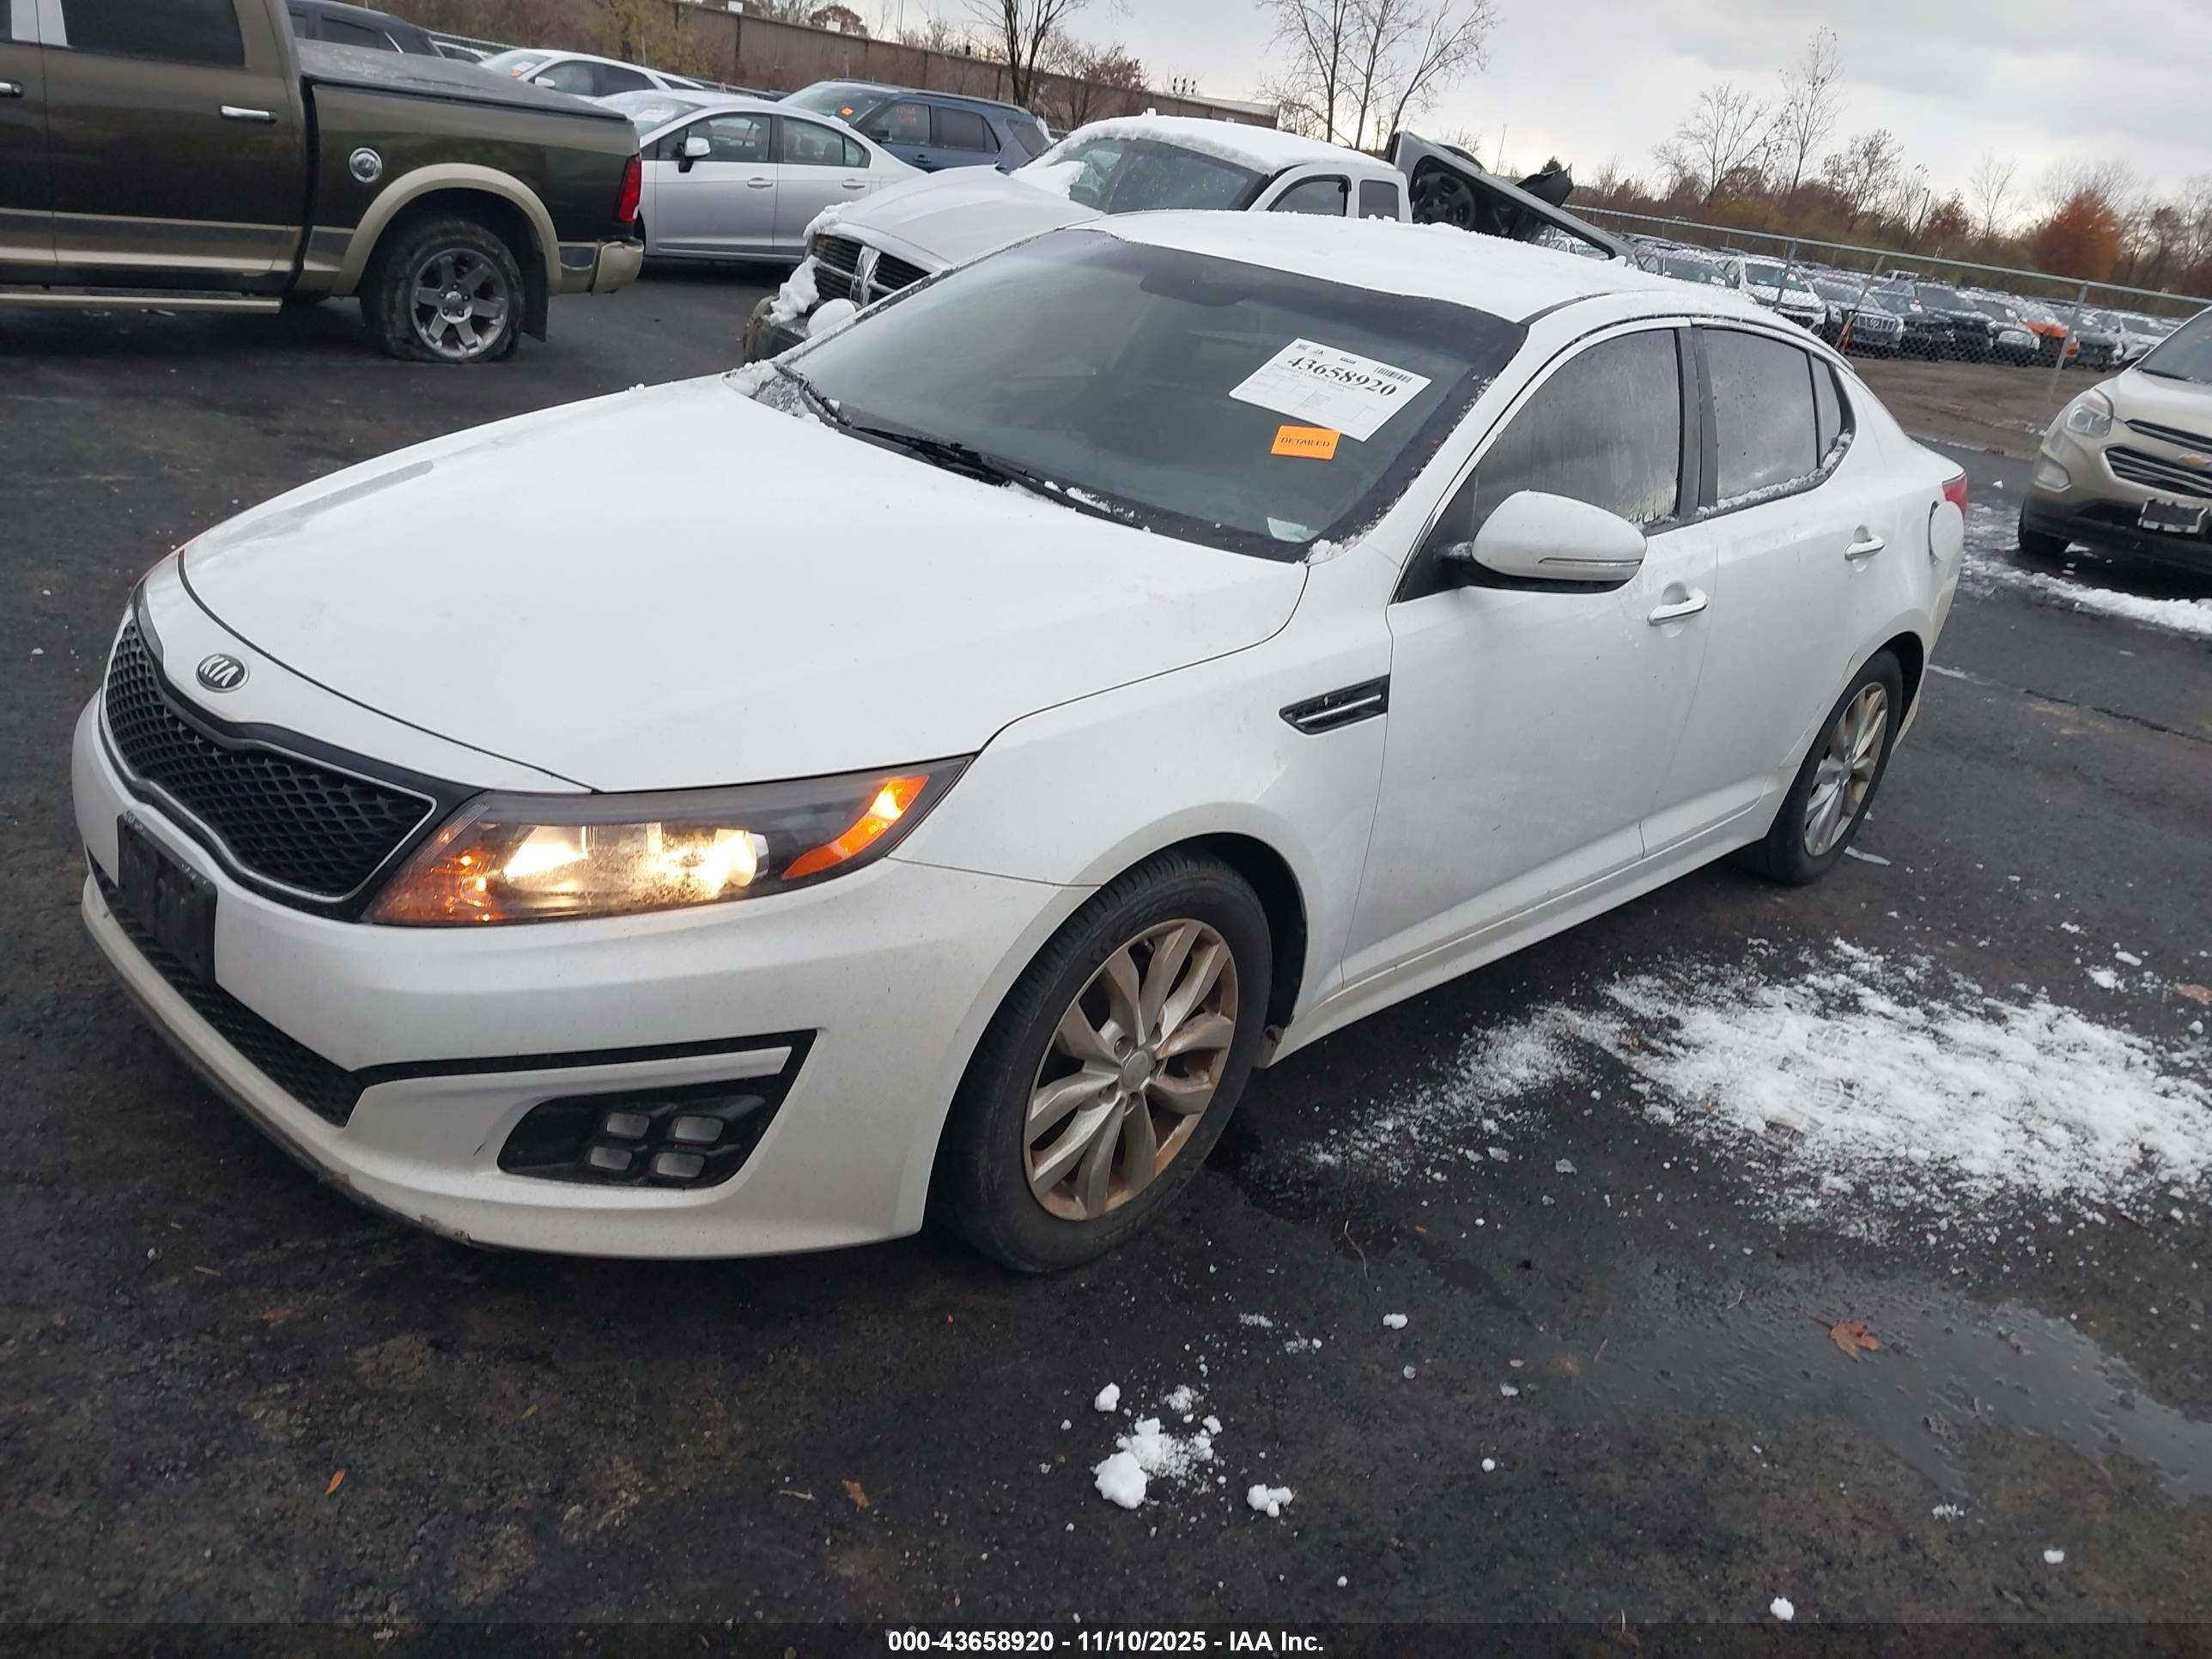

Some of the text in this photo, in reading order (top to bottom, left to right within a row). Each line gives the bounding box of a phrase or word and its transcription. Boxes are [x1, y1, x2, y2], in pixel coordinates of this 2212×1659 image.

[1288, 356, 1397, 397] 43658920
[1280, 436, 1331, 447] DETAILED
[199, 654, 240, 688] KIA
